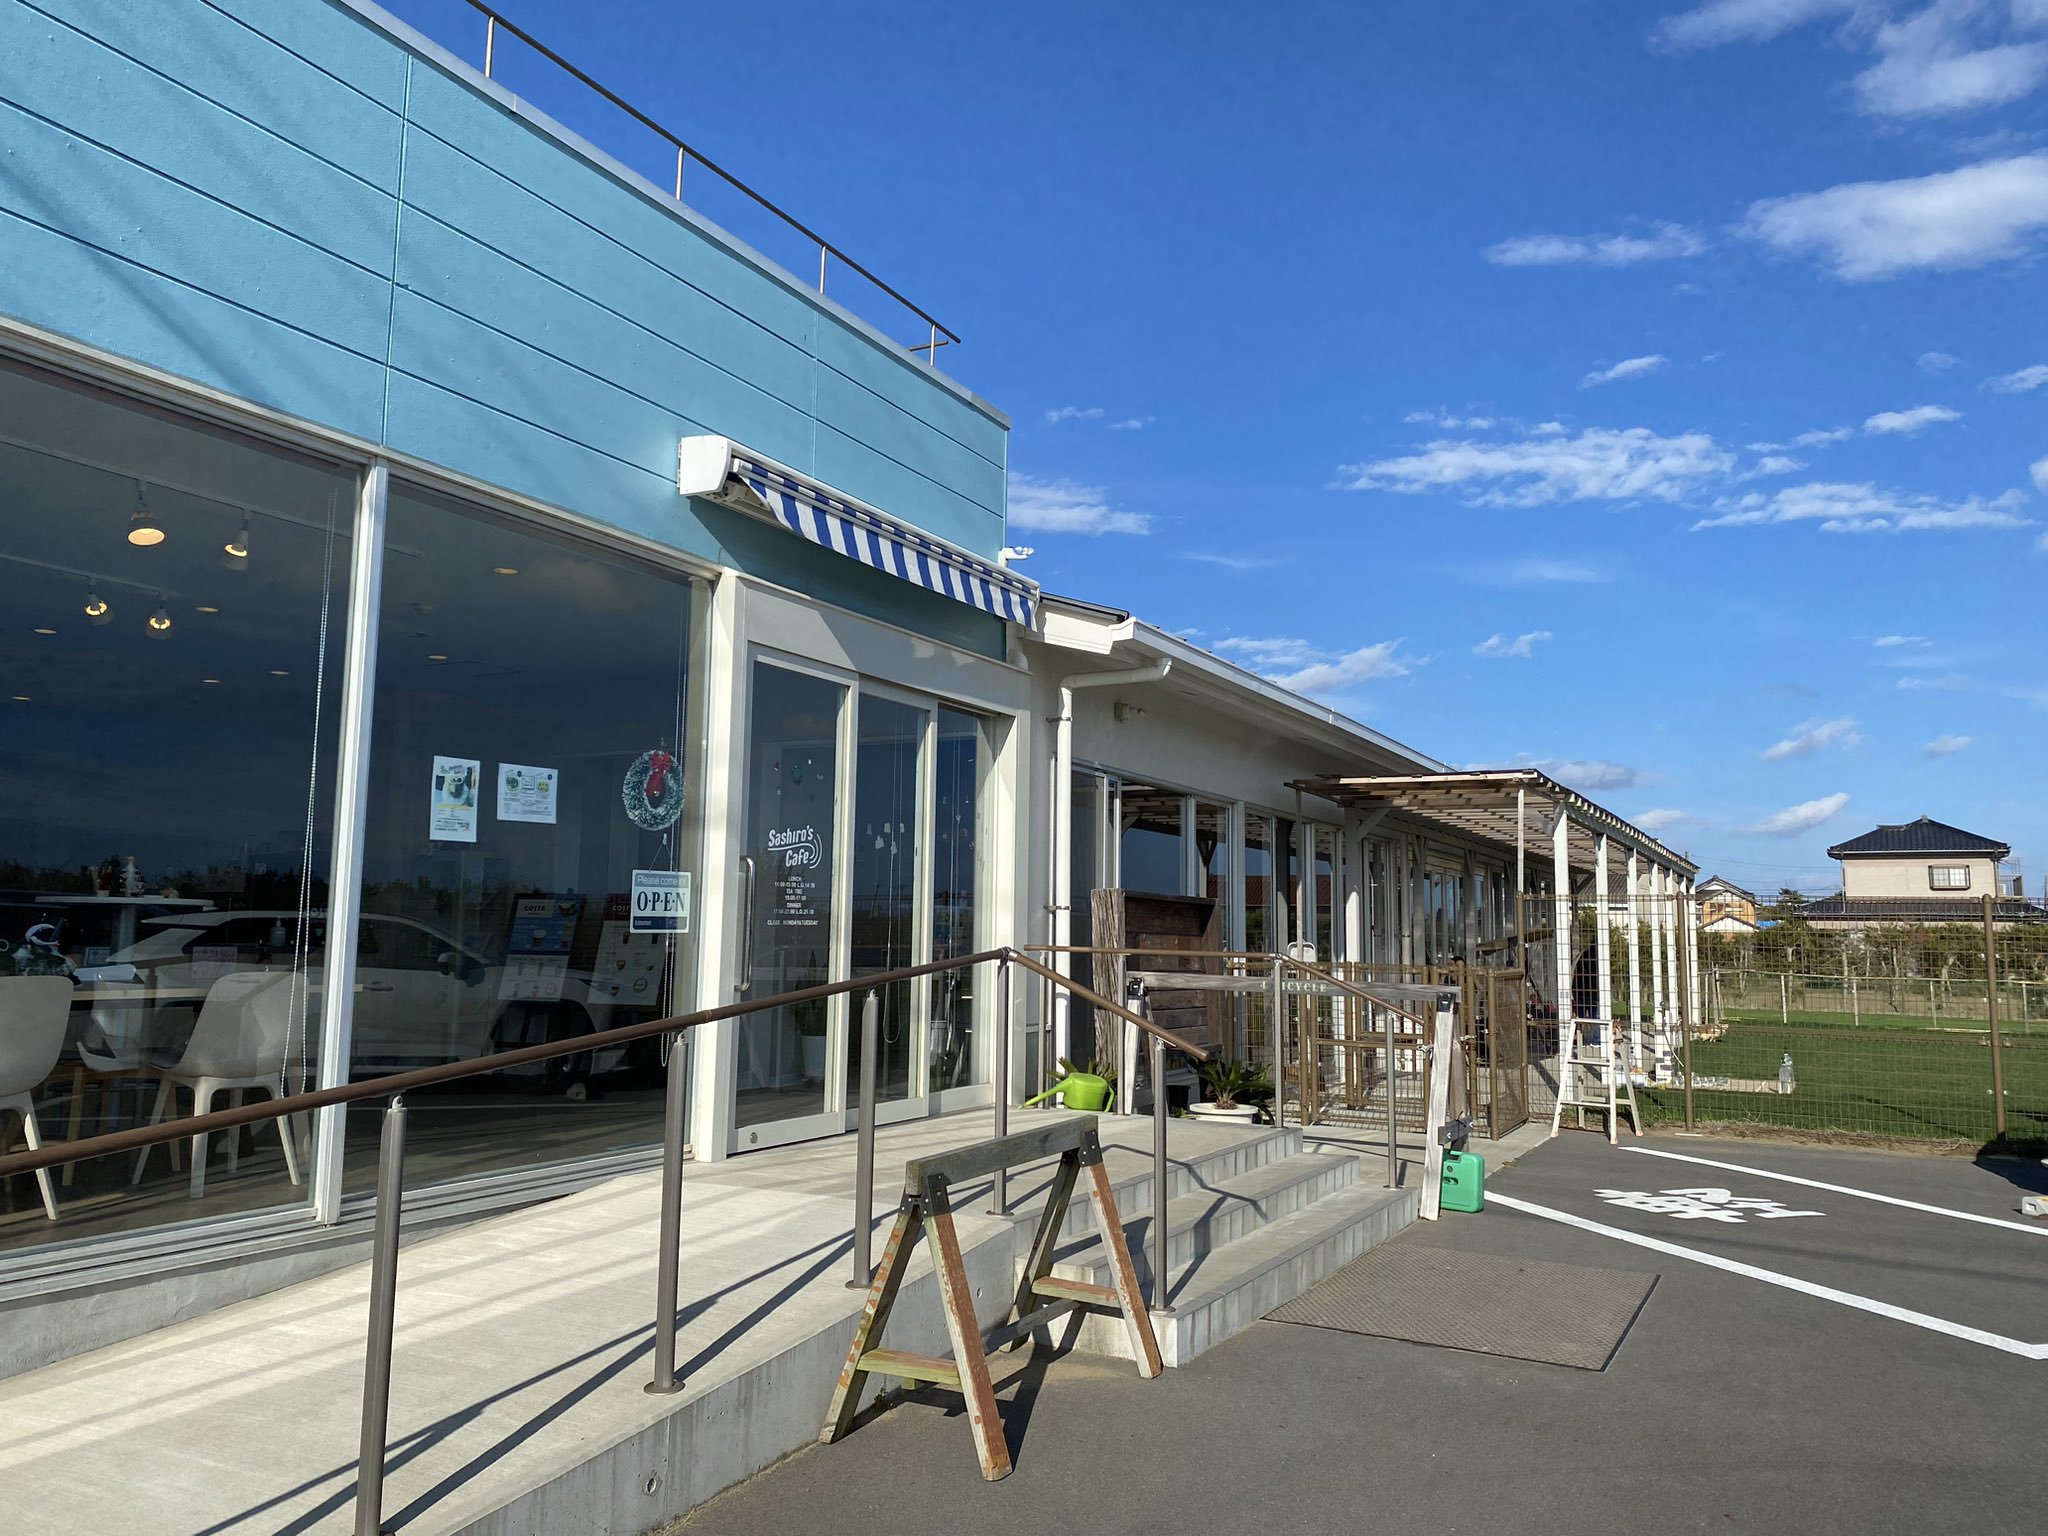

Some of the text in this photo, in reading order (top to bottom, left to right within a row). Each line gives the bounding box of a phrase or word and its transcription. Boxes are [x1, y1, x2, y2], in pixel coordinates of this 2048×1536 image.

[768, 825, 814, 847] Sashiro's
[785, 848, 809, 867] Cafe
[637, 875, 659, 885] Please
[660, 877, 677, 885] come
[524, 904, 546, 912] COSTA
[612, 904, 631, 912] COST
[1279, 981, 1327, 993] ICYCLE
